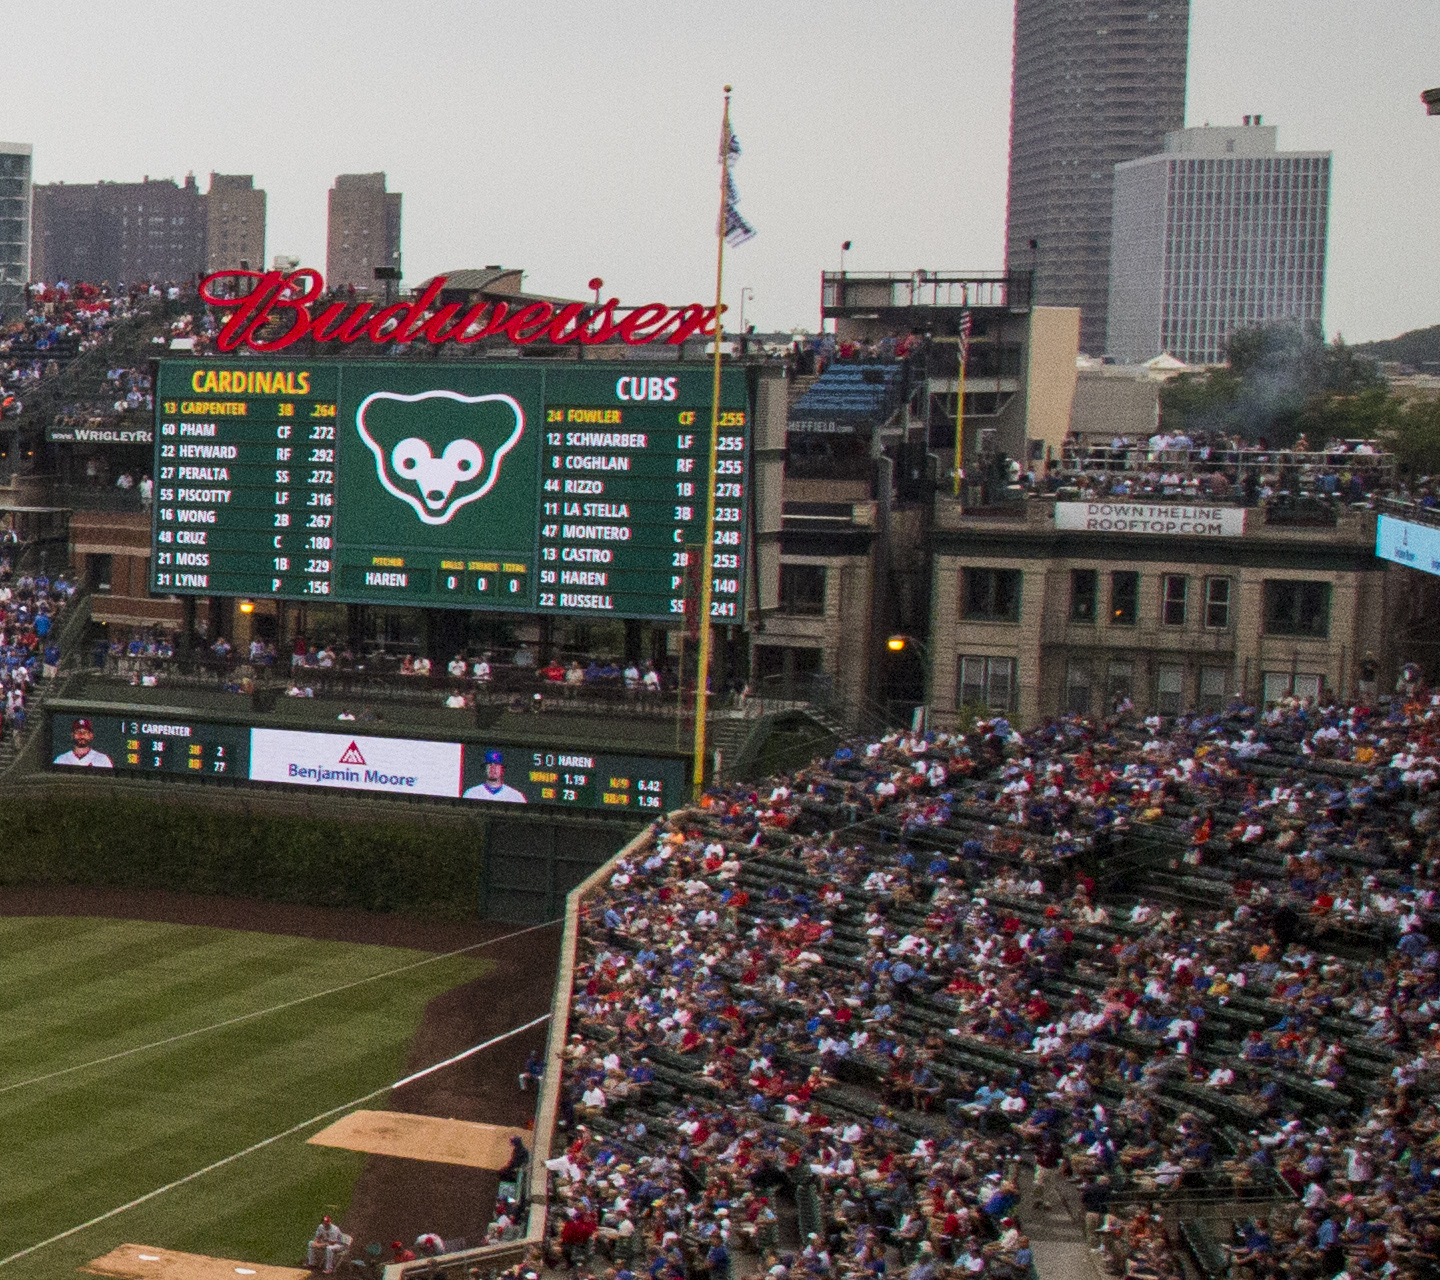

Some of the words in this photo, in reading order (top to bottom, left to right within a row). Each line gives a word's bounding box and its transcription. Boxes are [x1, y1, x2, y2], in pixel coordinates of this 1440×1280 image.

[198, 268, 728, 352] Budweiser
[192, 371, 310, 394] CARDINALS
[616, 377, 679, 401] CUBS
[164, 402, 177, 414] 13
[181, 402, 247, 415] CARPENTER
[547, 410, 563, 422] 24
[568, 410, 622, 423] FOWLER
[162, 424, 176, 435] 60
[180, 424, 217, 436] PHAM
[547, 433, 561, 445] 12
[566, 433, 648, 448] SCHWARBER
[161, 445, 176, 457] 22
[179, 445, 238, 459] HEYWARD
[552, 456, 561, 468] 8
[565, 457, 631, 471] COGHLAN
[161, 467, 175, 479] 27
[178, 467, 229, 481] PERALTA
[544, 479, 560, 491] 44
[565, 480, 604, 494] RIZZO
[160, 489, 174, 501] 55
[178, 489, 231, 503] PISCOTTY
[160, 508, 173, 520] 16
[177, 510, 216, 523] WONG
[544, 503, 559, 515] 11
[564, 503, 581, 516] LA
[583, 504, 629, 518] STELLA
[1087, 505, 1143, 516] DOWN
[1148, 508, 1178, 518] THE
[1182, 509, 1222, 520] LINE
[542, 525, 558, 537] 47
[562, 525, 632, 539] MONTERO
[1087, 520, 1221, 535] ROOFTOP.COM
[176, 532, 207, 544] CRUZ
[158, 553, 172, 564] 21
[176, 553, 209, 566] MOSS
[542, 548, 558, 560] 13
[562, 548, 613, 563] CASTRO
[157, 574, 171, 585] 31
[175, 574, 208, 587] LYNN
[366, 572, 408, 587] HAREN
[541, 571, 557, 583] 50
[561, 571, 607, 585] HAREN
[539, 593, 556, 605] 22
[560, 594, 613, 609] RUSSELL
[141, 721, 191, 737] CARPENTER
[558, 755, 594, 768] HAREN
[289, 763, 359, 782] Benjamin
[364, 770, 415, 786] Moore
